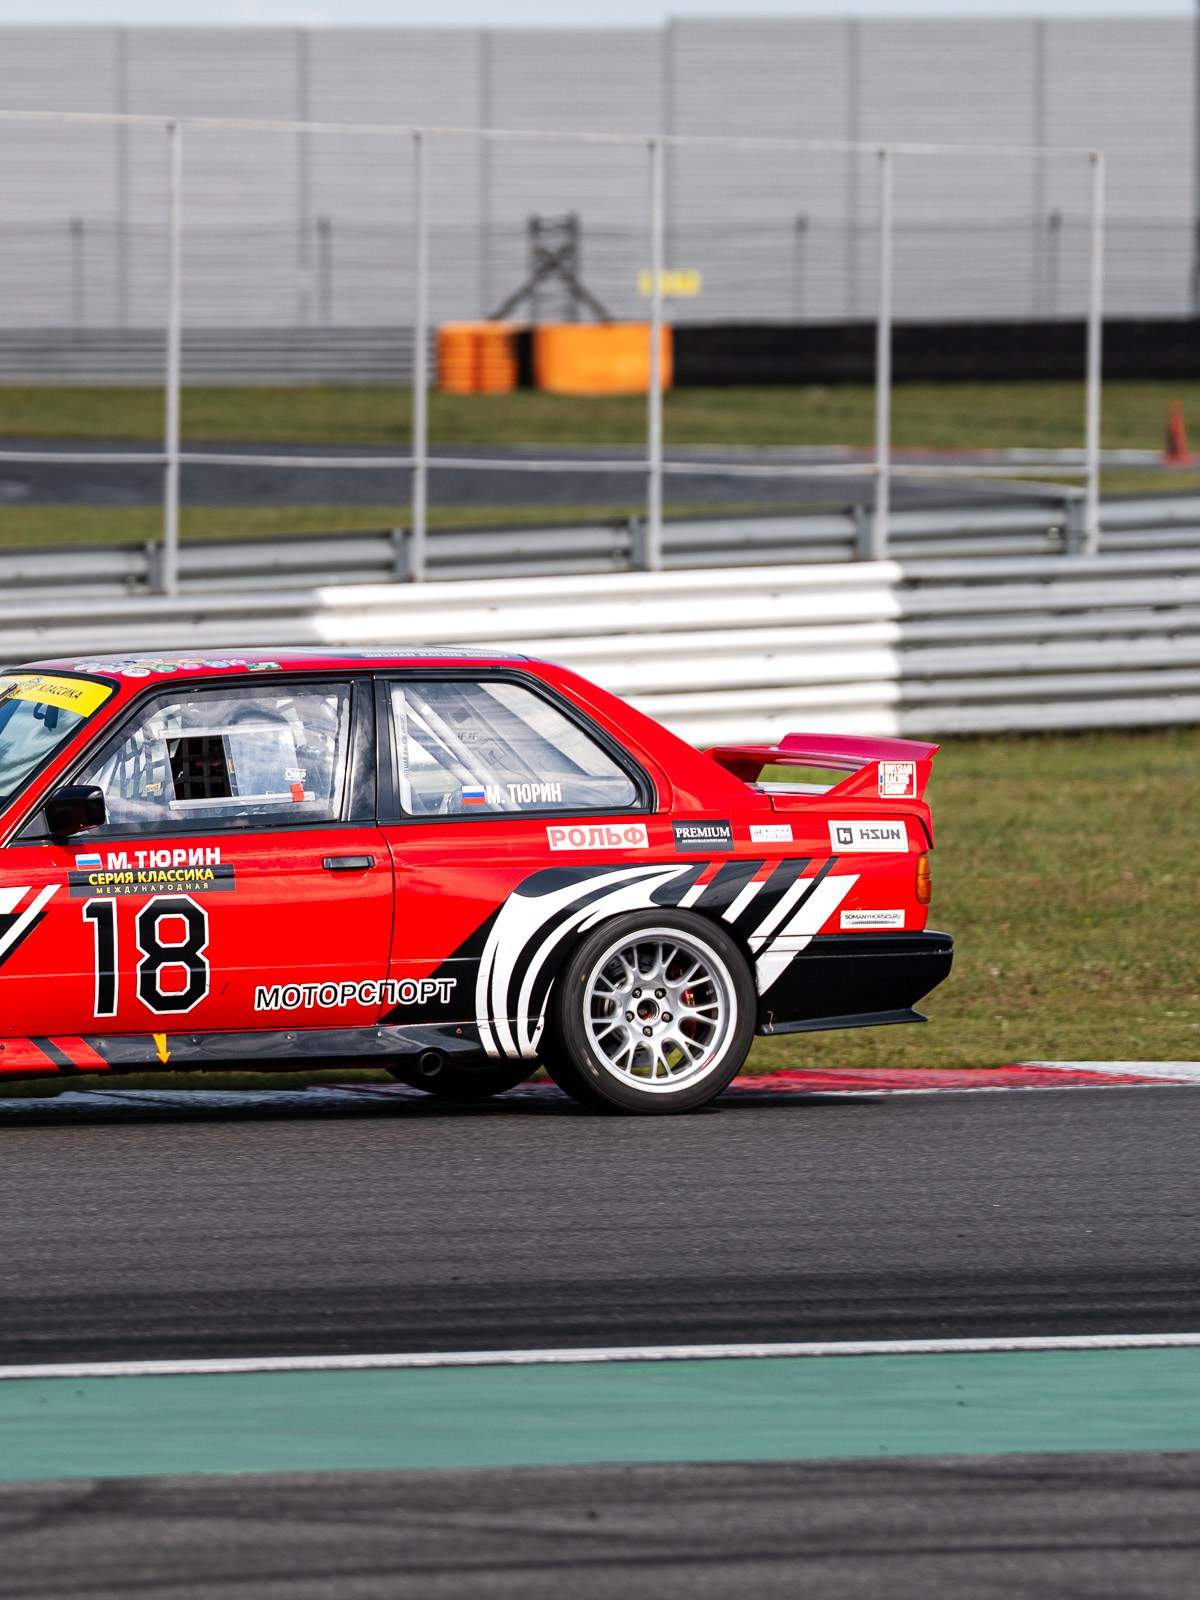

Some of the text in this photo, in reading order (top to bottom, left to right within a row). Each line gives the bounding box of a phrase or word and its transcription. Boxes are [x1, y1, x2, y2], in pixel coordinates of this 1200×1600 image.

[485, 782, 562, 804] М. ТЮРИН
[550, 827, 645, 847] РОЛЬФ
[675, 826, 731, 838] PREMIUM
[88, 868, 215, 886] СЕРИЯ КЛАССИКА
[96, 882, 209, 894] МЕЖДУНАРОДНАЯ
[82, 894, 210, 1018] 18
[254, 978, 457, 1010] МОТОРСПОРТ
